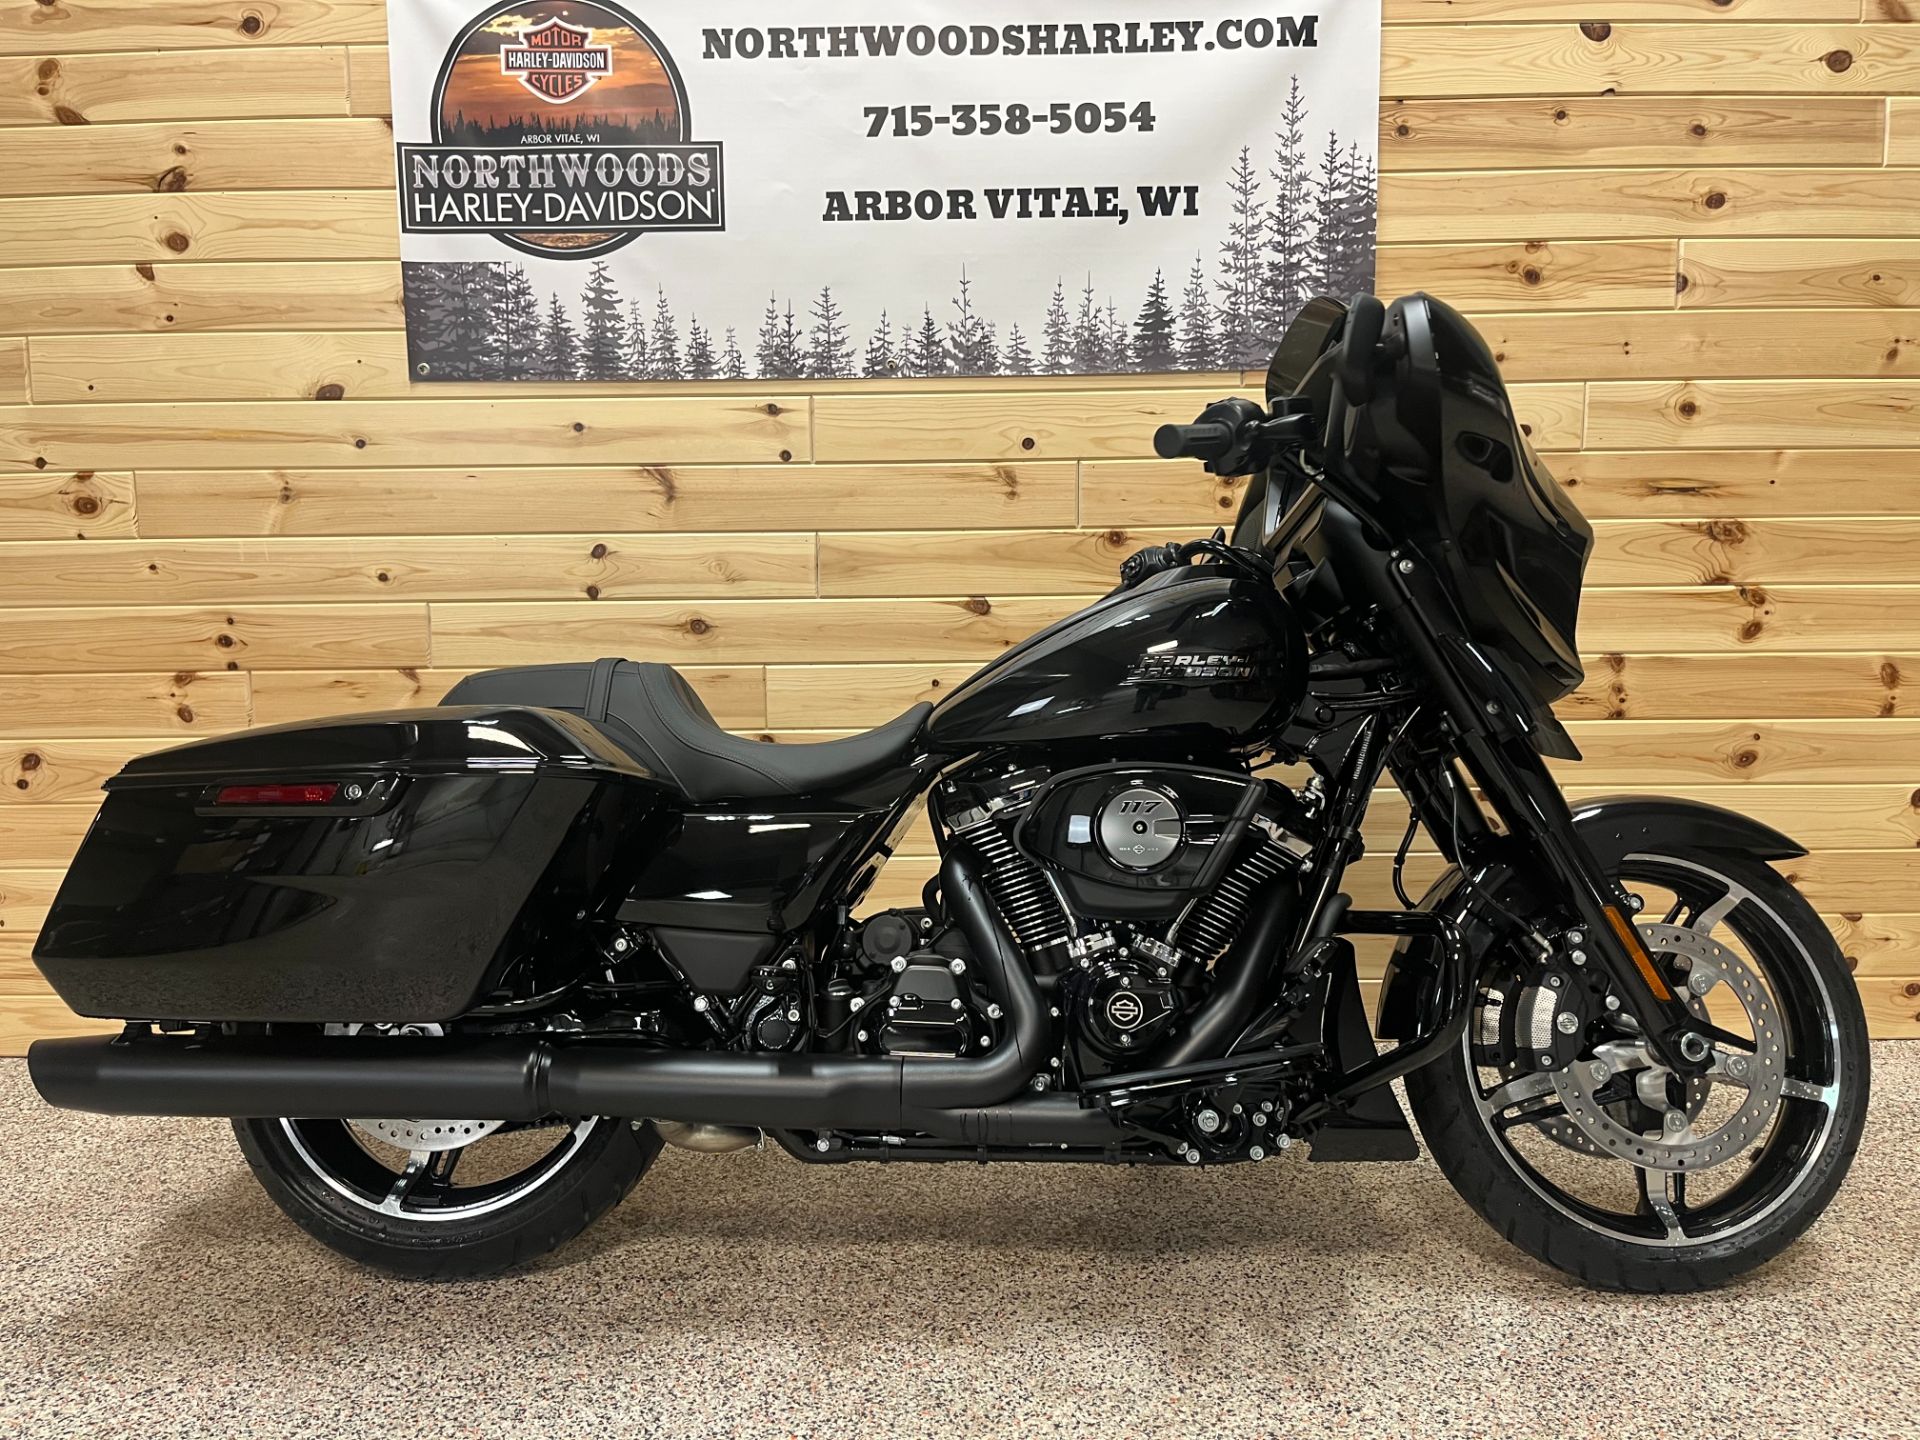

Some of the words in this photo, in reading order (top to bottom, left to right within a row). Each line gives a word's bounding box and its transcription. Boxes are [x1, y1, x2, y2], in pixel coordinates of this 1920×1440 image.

[531, 26, 581, 46] MOTOR
[702, 15, 1318, 59] NORTHWOODSHARLEY.COM
[508, 52, 604, 68] HARLEY-DAVIDSON
[531, 75, 583, 96] CYCLES
[864, 102, 1155, 137] 715-358-5054
[520, 134, 552, 144] ARBOR
[554, 133, 583, 144] VITAE,
[586, 133, 600, 143] WI
[412, 152, 711, 189] NORTHWOODS
[414, 190, 714, 222] HARLEY-DAVIDSON
[823, 190, 976, 221] ARBOR
[984, 187, 1128, 225] VITAE,
[1137, 186, 1198, 216] WI
[1119, 800, 1164, 815] 117
